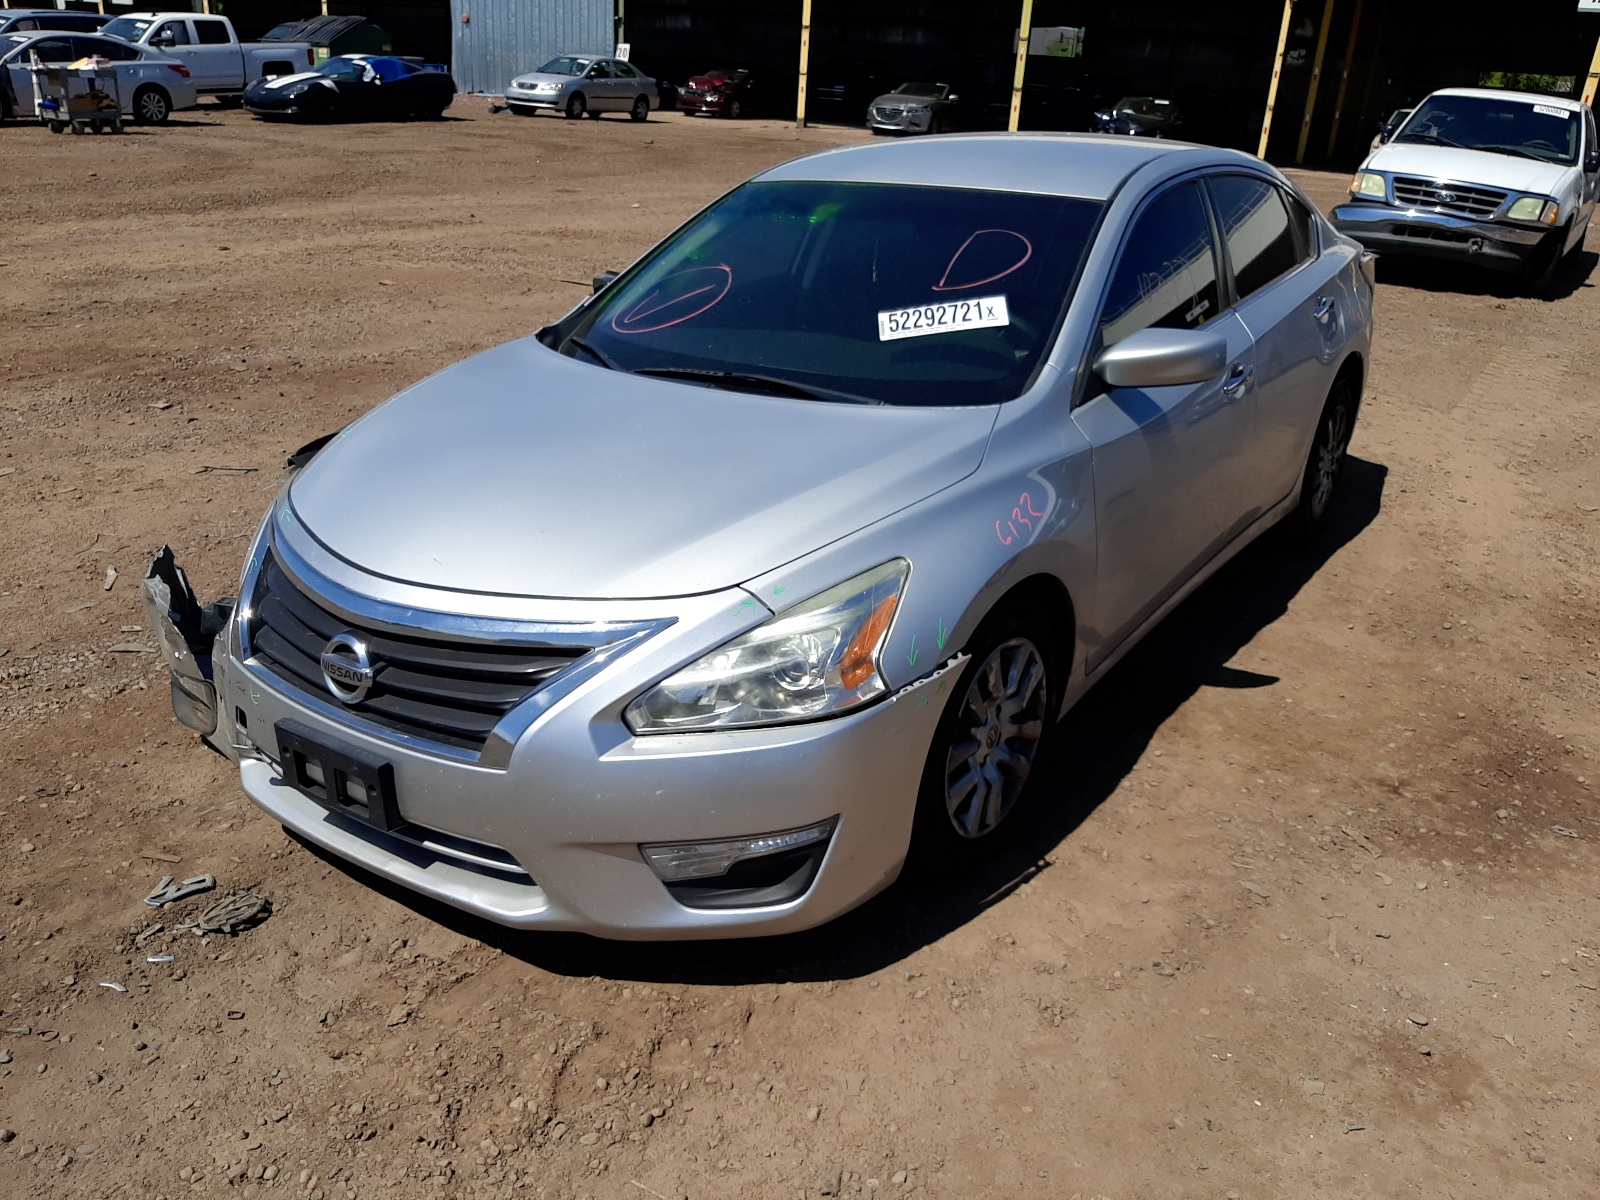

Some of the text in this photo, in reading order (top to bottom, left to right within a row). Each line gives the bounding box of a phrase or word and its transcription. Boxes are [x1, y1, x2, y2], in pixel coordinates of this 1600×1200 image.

[617, 47, 628, 58] 20
[888, 301, 983, 333] 52292721
[994, 491, 1044, 546] 6132
[321, 658, 363, 683] NISSAN
